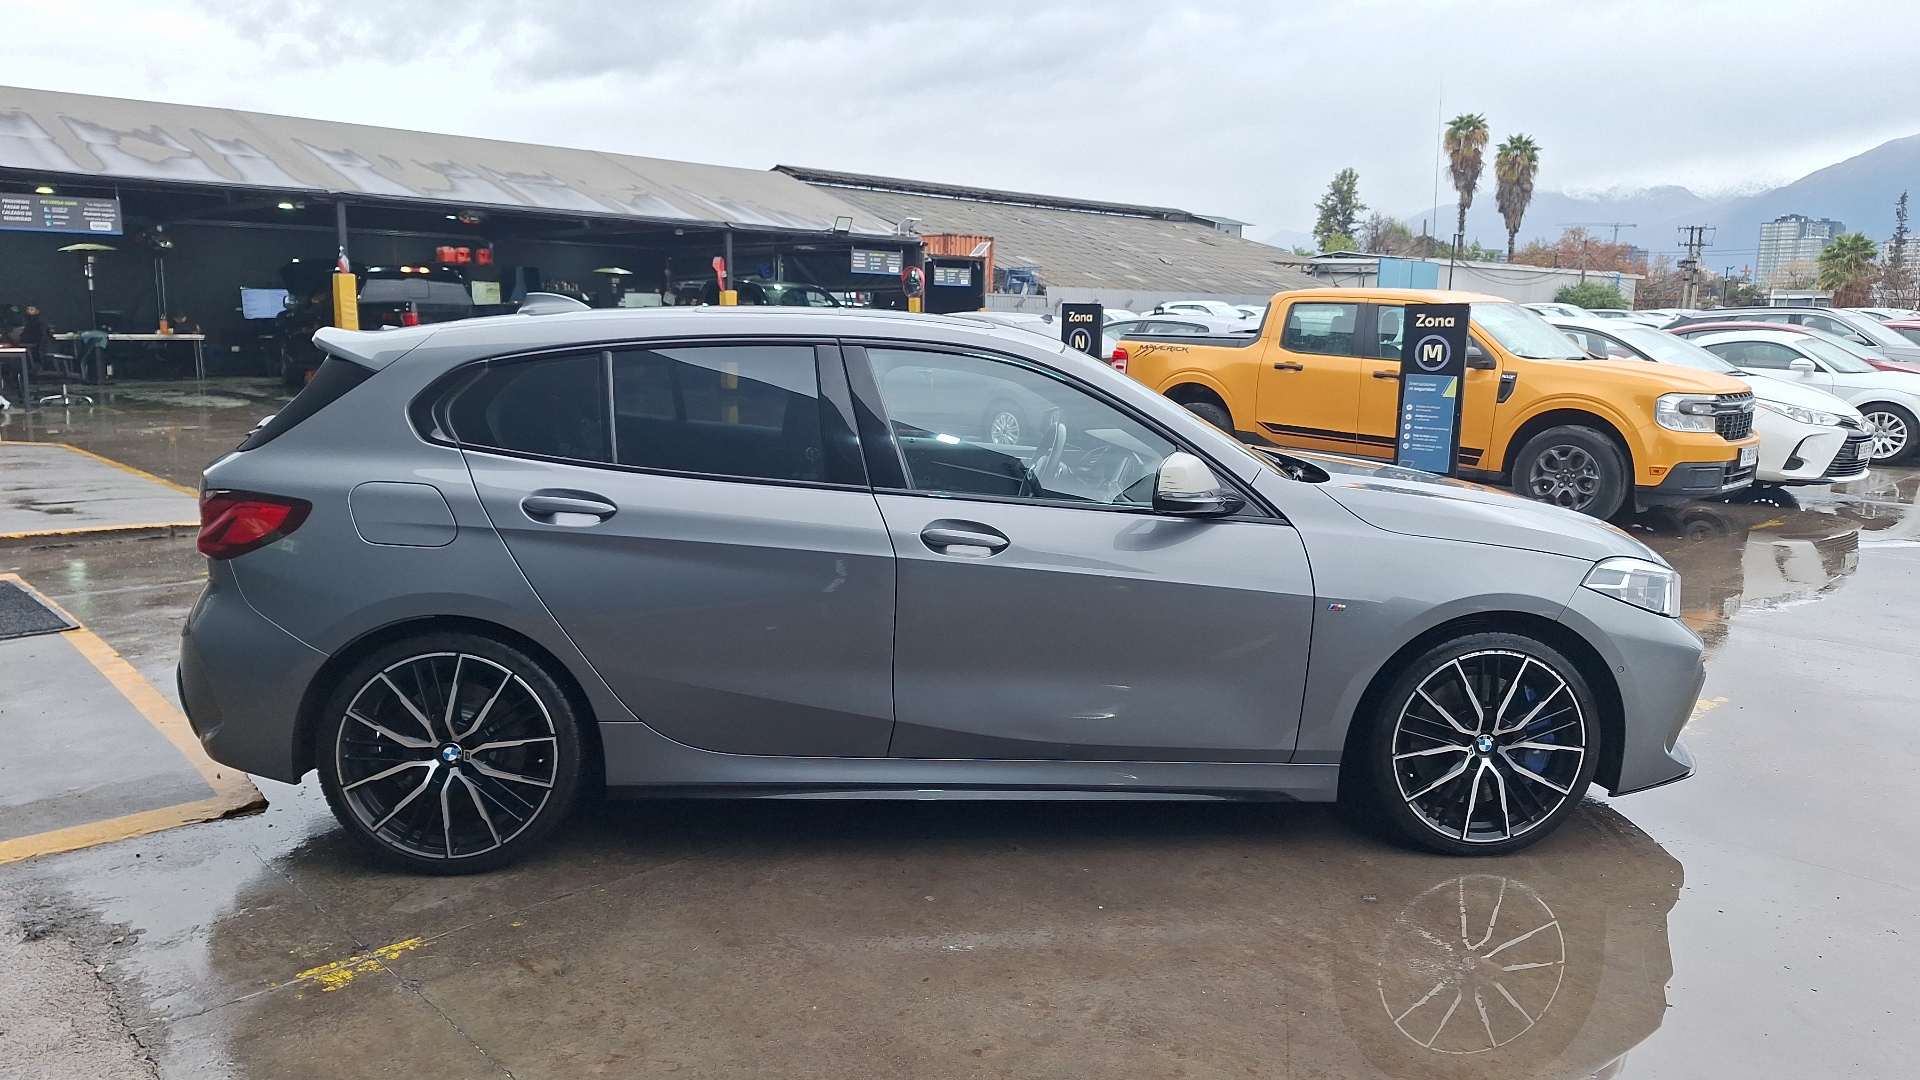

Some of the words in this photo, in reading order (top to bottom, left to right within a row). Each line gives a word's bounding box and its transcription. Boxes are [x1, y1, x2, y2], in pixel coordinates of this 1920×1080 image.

[1068, 311, 1093, 322] Zona
[1415, 313, 1455, 327] Zona
[1074, 335, 1086, 349] N
[1137, 344, 1189, 355] MAVERICK
[1422, 344, 1443, 362] M
